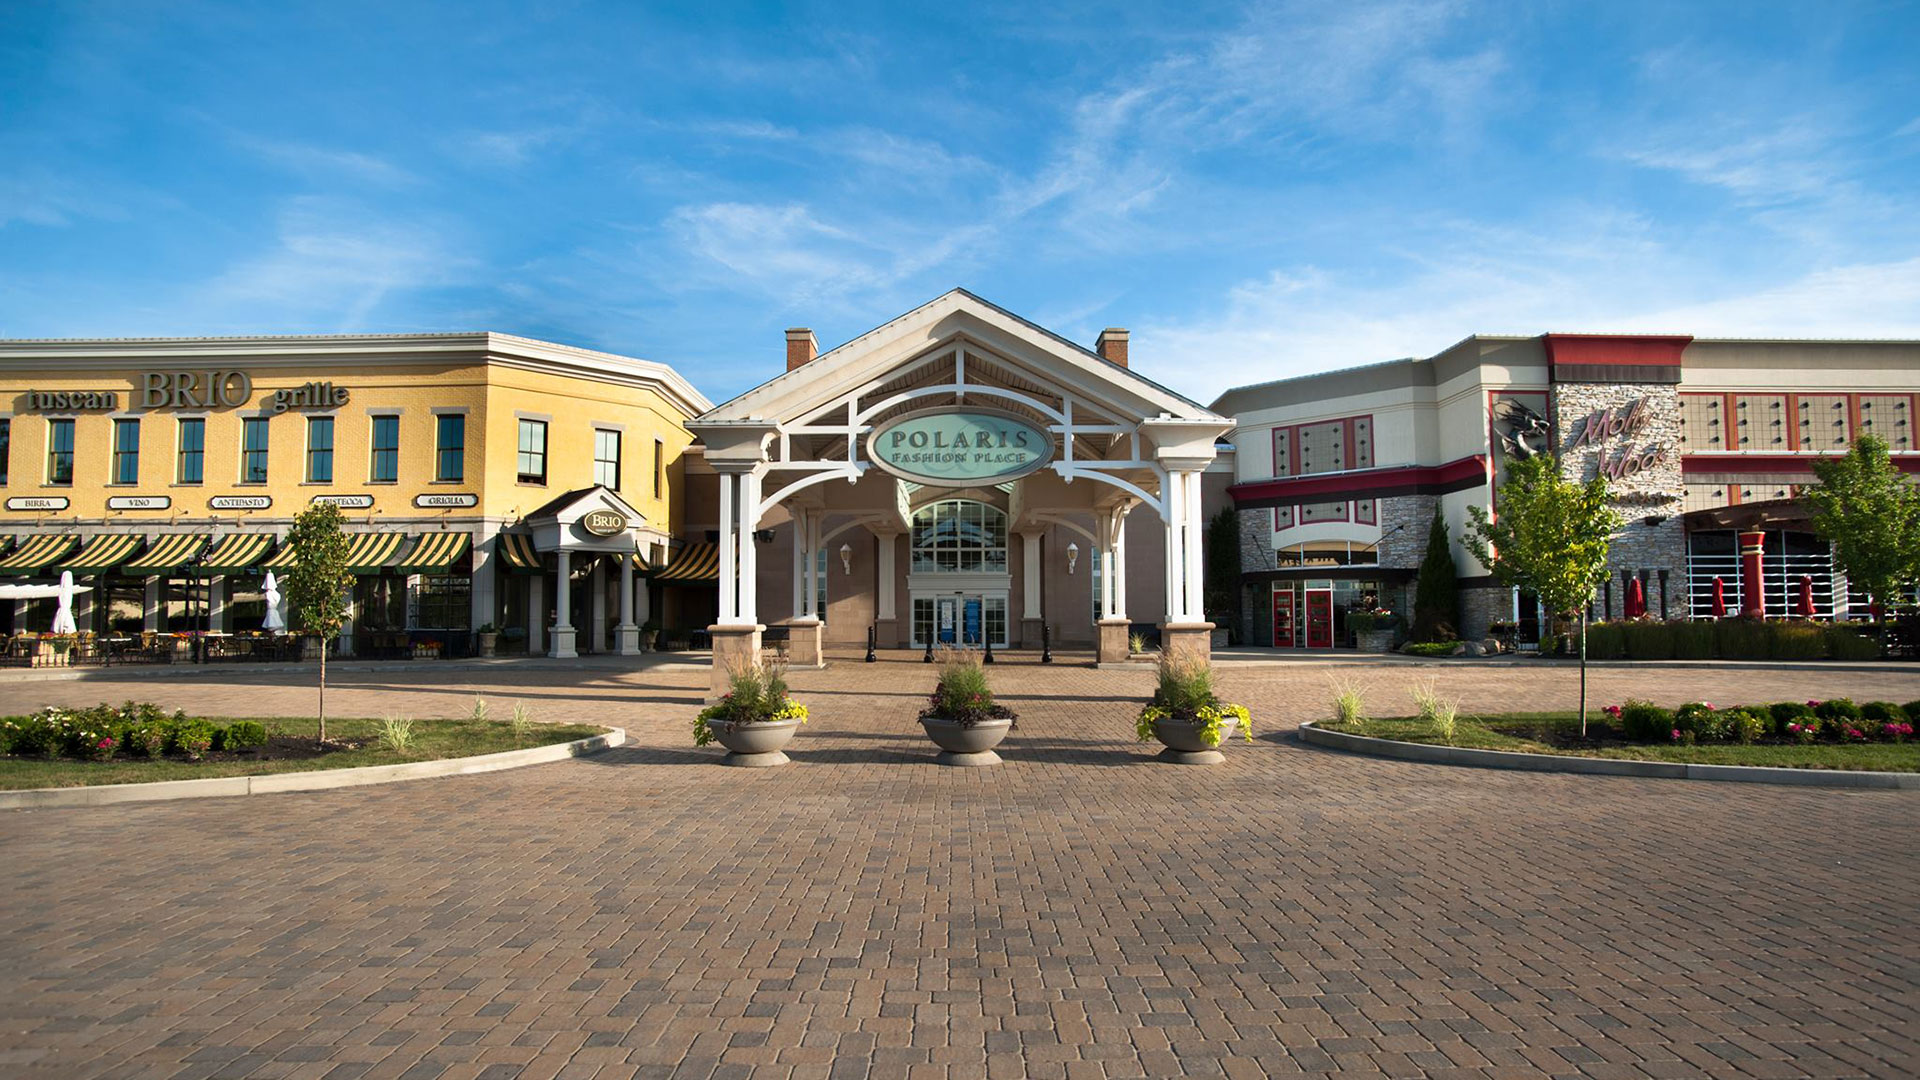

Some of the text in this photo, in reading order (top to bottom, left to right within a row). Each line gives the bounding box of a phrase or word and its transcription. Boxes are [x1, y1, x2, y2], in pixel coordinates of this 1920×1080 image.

[26, 370, 350, 412] tuscan BRIO grille
[1573, 396, 1653, 446] Molly
[891, 431, 1028, 449] POLARIS
[891, 452, 1026, 463] FASHION PLACE
[25, 499, 51, 508] BIRRA
[128, 498, 150, 507] VINO
[592, 514, 621, 528] BRIO
